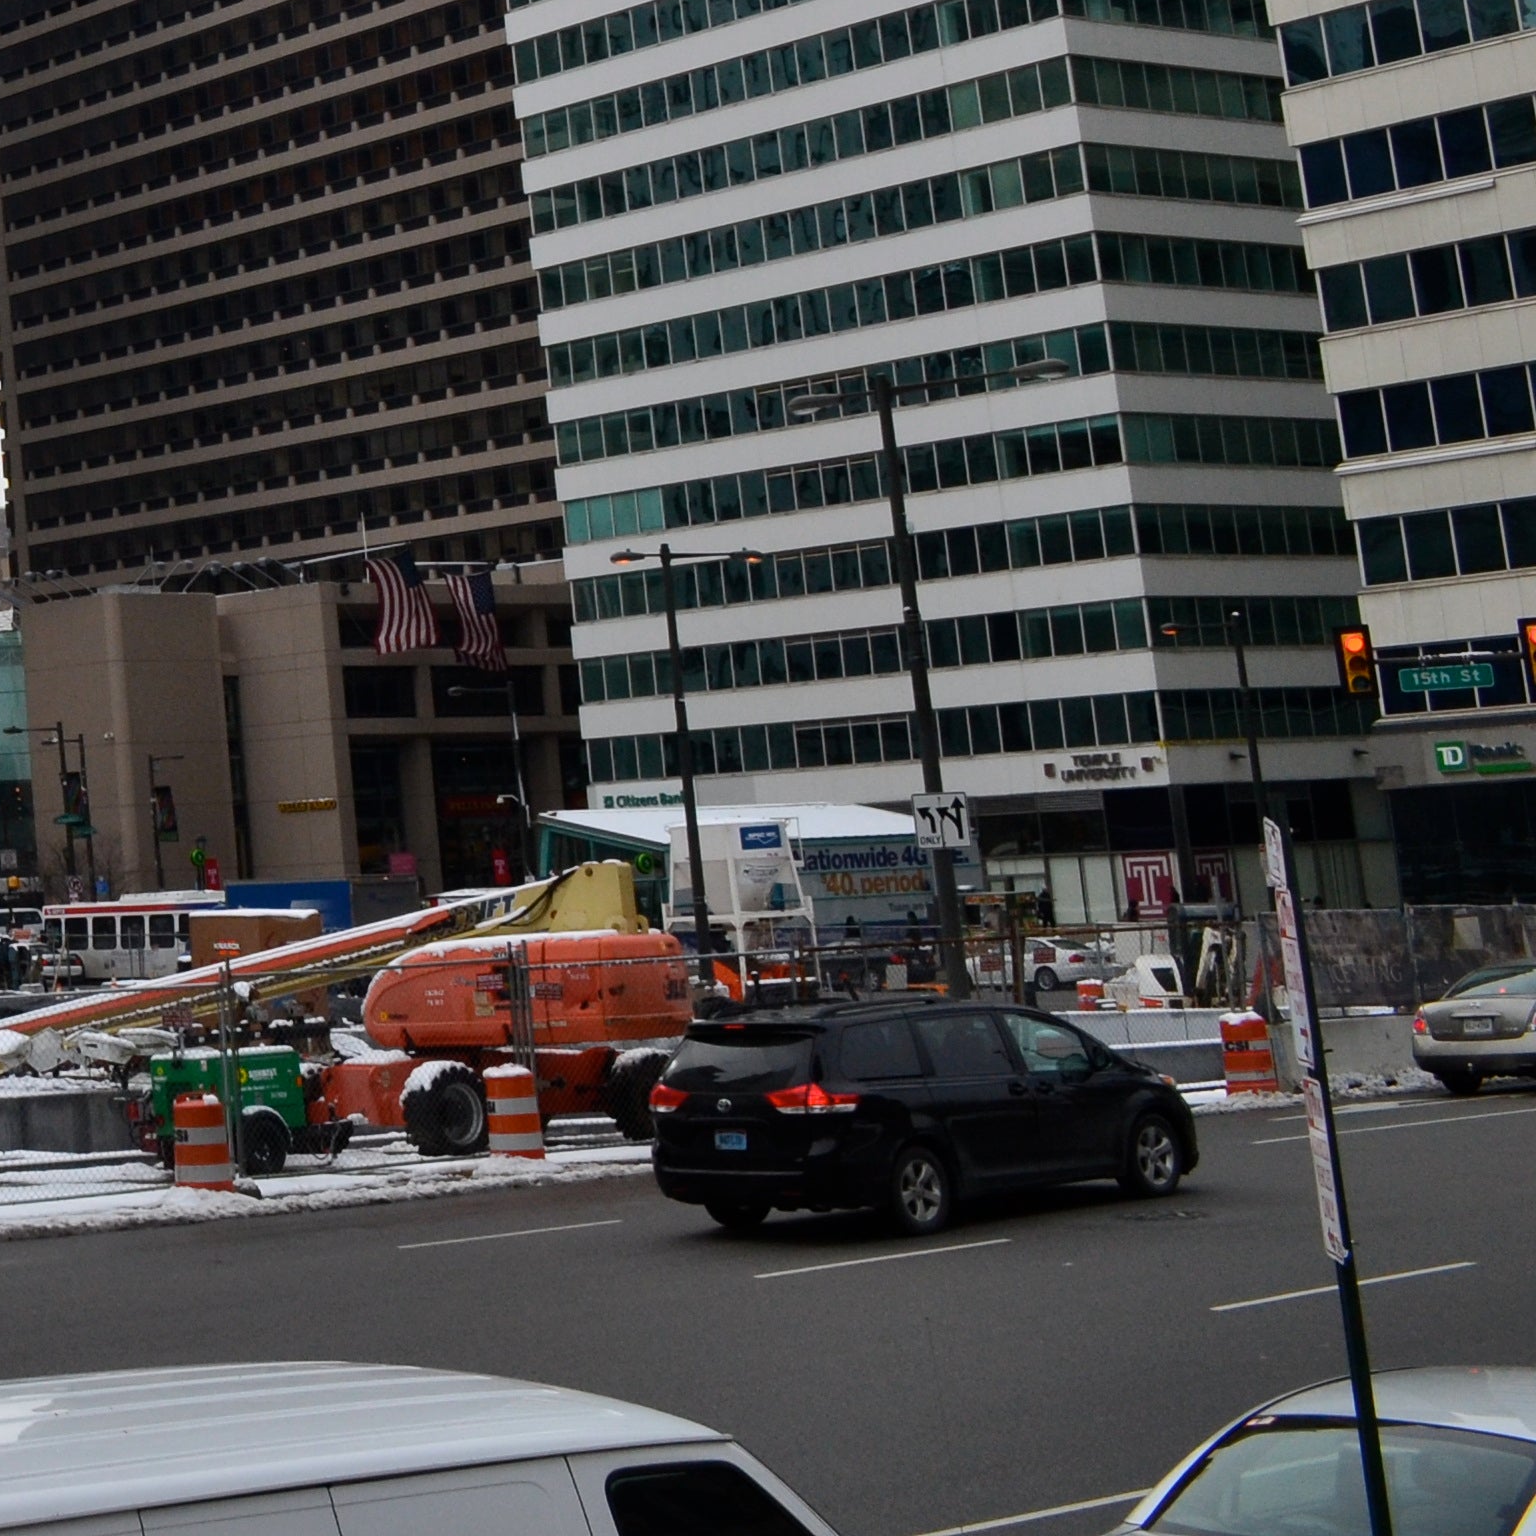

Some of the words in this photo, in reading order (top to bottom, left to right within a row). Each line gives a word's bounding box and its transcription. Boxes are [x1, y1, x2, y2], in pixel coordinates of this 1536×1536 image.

[1413, 671, 1451, 686] 15th
[1460, 669, 1481, 682] St
[1071, 752, 1122, 768] TEMPLE
[1436, 746, 1463, 766] TD
[1061, 766, 1137, 783] UNIVERSITY
[616, 795, 659, 808] Citizens
[920, 835, 942, 845] ONLY
[794, 846, 898, 871] Nationwide
[901, 845, 928, 865] 4G
[1225, 1041, 1249, 1051] CSI
